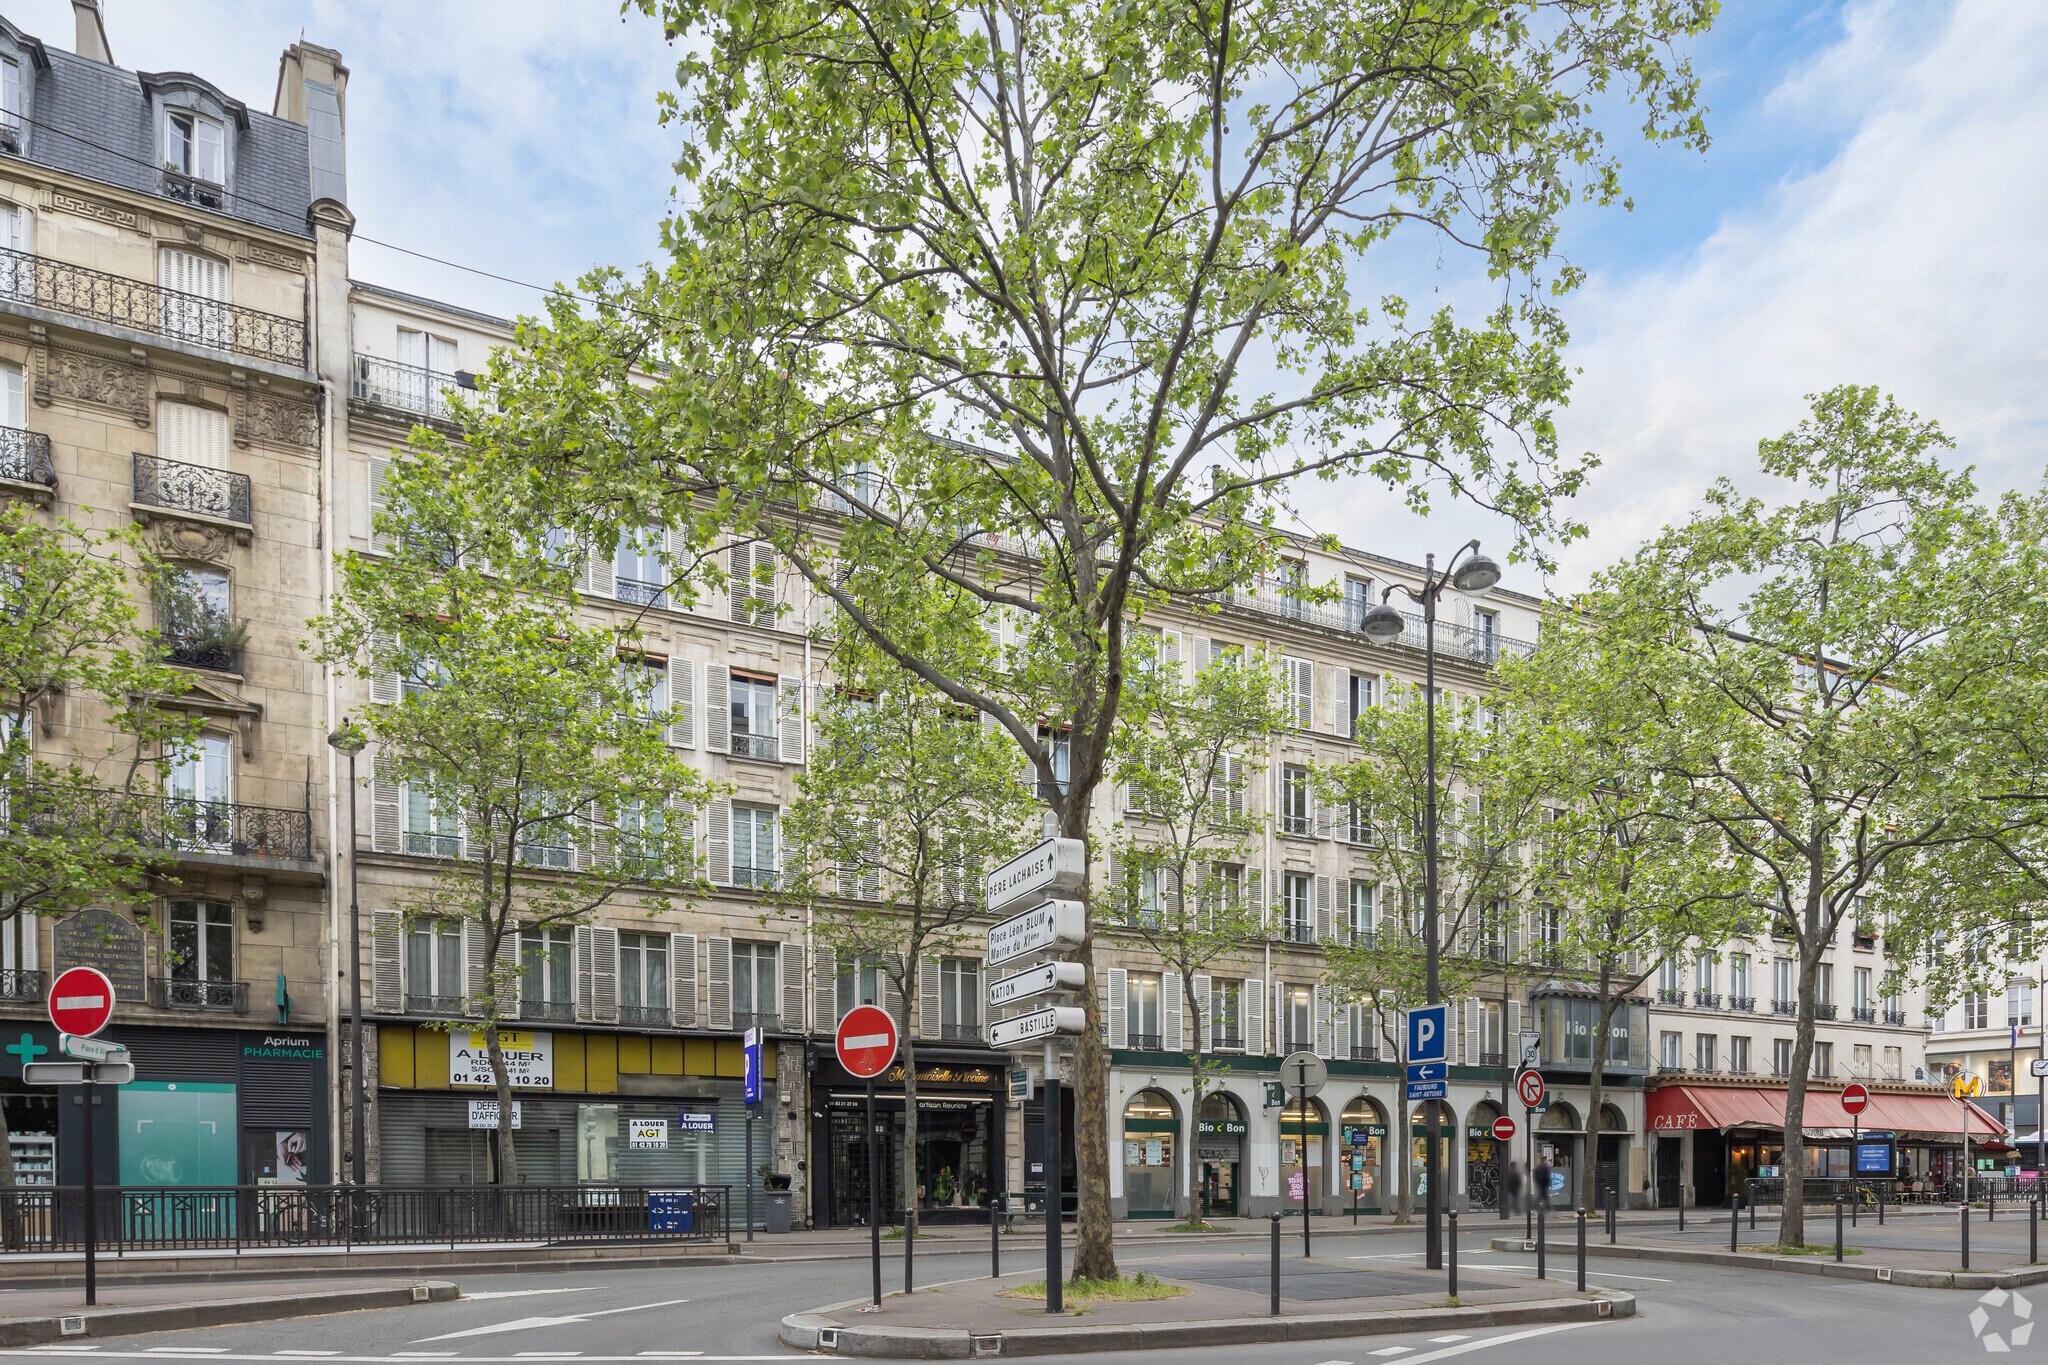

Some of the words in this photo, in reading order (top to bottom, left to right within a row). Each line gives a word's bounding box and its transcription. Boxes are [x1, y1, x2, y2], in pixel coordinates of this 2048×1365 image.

[1009, 859, 1044, 888] LACHAISE
[990, 931, 1006, 945] Place
[1009, 924, 1023, 938] Léon
[1026, 912, 1045, 930] BLUM
[991, 945, 1010, 960] Mairie
[1013, 940, 1020, 952] du
[991, 982, 1015, 1000] NATION
[1020, 1014, 1054, 1034] BASTILLE
[482, 1032, 519, 1042] GT
[1418, 1018, 1434, 1052] P
[1608, 1026, 1628, 1038] on
[264, 1036, 310, 1046] Aprium
[81, 1044, 94, 1053] Place
[244, 1048, 324, 1058] PHARMACIE
[456, 1050, 471, 1058] A
[478, 1050, 544, 1061] LUER
[454, 1074, 468, 1082] 01
[474, 1074, 490, 1083] 42
[515, 1076, 530, 1084] 10
[534, 1076, 550, 1085] 20
[888, 1068, 952, 1082] Maemoiselle
[953, 1070, 989, 1083] Pivoine
[1954, 1076, 1978, 1098] M
[1408, 1090, 1442, 1098] SAINT-ANTOINE
[1654, 1110, 1698, 1130] CAFÉ
[1199, 1122, 1214, 1132] Bio
[1226, 1124, 1244, 1132] Bon
[1369, 1126, 1385, 1134] Bon
[1470, 1128, 1482, 1136] Bio
[638, 1128, 660, 1138] AGT
